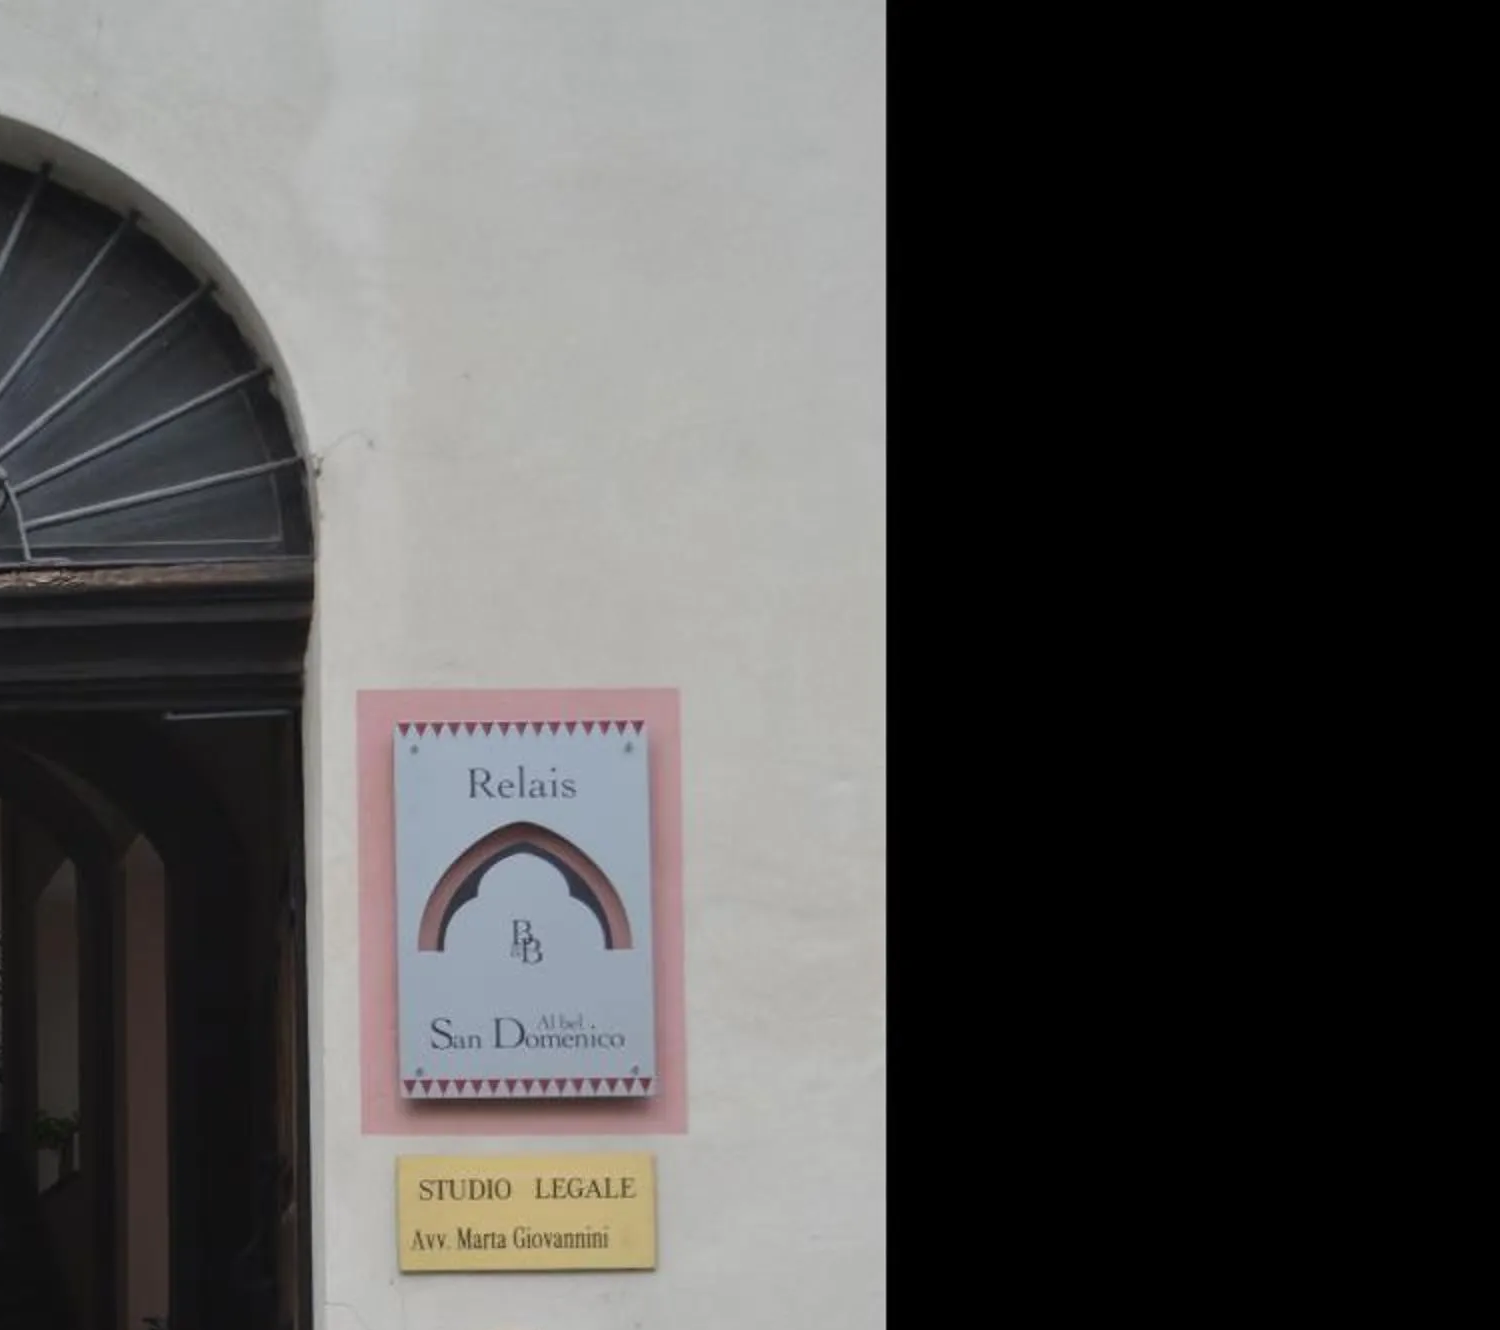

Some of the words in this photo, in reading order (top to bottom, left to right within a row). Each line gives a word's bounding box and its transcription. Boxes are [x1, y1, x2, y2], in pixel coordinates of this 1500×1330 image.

[467, 764, 578, 799] Relais
[430, 1016, 482, 1051] San
[493, 1016, 626, 1050] Domenico
[418, 1177, 513, 1201] STUDIO
[534, 1176, 637, 1200] LEGALE
[410, 1228, 451, 1251] Avv.
[456, 1226, 507, 1250] Marta
[512, 1225, 610, 1250] Giovannini
